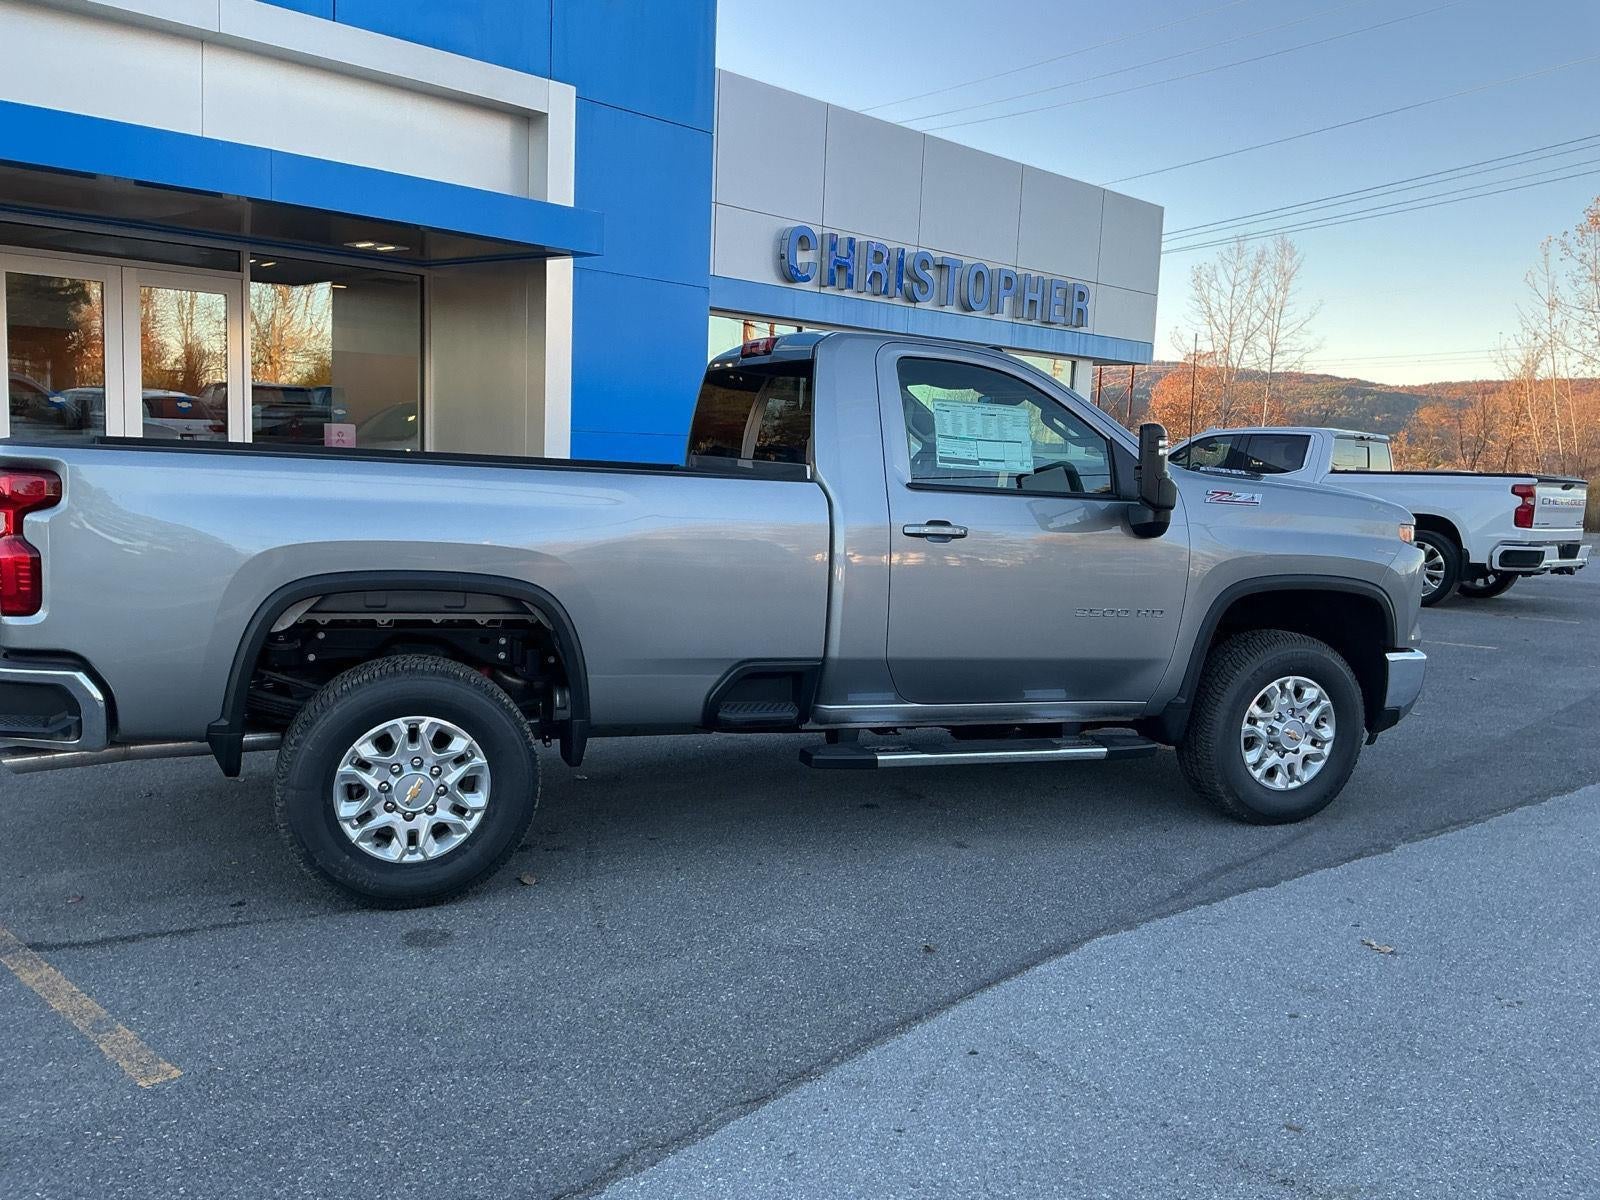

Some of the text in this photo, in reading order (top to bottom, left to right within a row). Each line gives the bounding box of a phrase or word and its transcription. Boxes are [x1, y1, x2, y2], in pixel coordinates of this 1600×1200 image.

[780, 225, 1090, 327] CHRISTOPHER
[1204, 489, 1263, 506] Z71
[1136, 607, 1165, 618] HD
